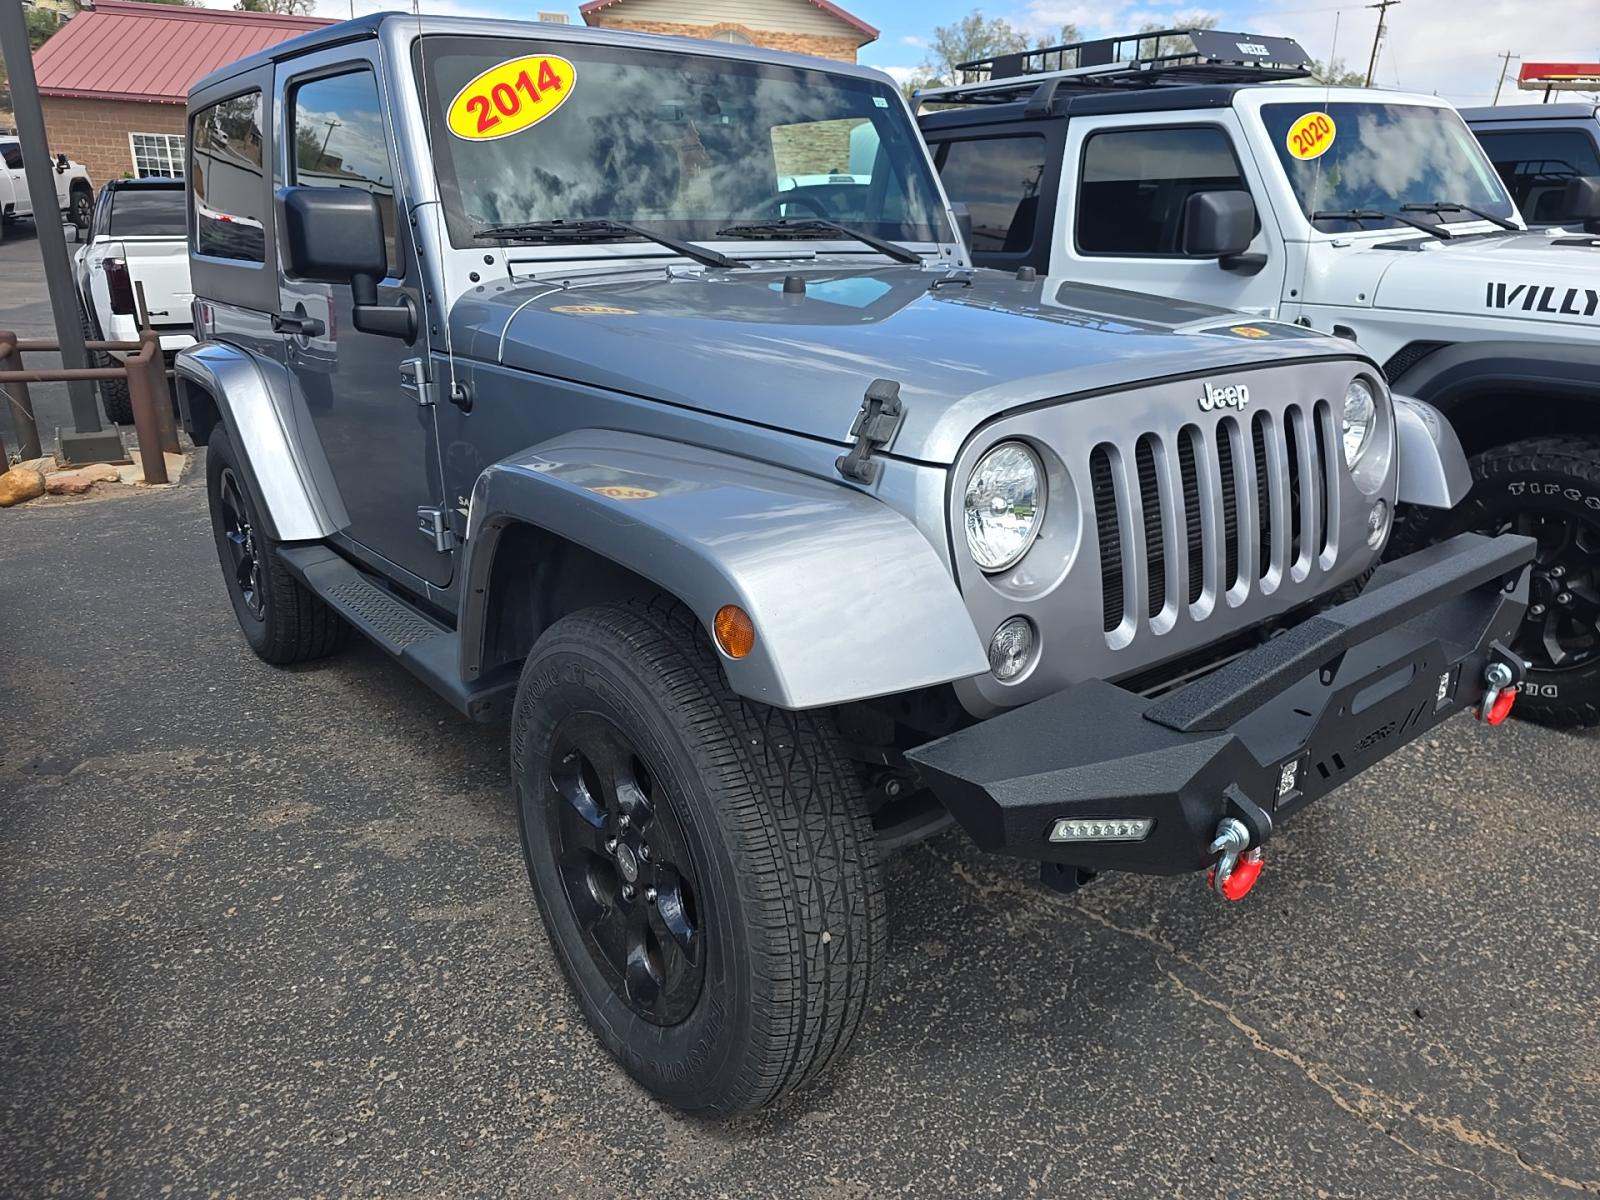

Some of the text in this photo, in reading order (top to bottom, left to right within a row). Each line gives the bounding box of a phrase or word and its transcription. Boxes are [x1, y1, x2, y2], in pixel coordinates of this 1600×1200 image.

[466, 60, 563, 134] 2014
[1293, 115, 1330, 156] 2020
[1199, 383, 1249, 411] Jeep
